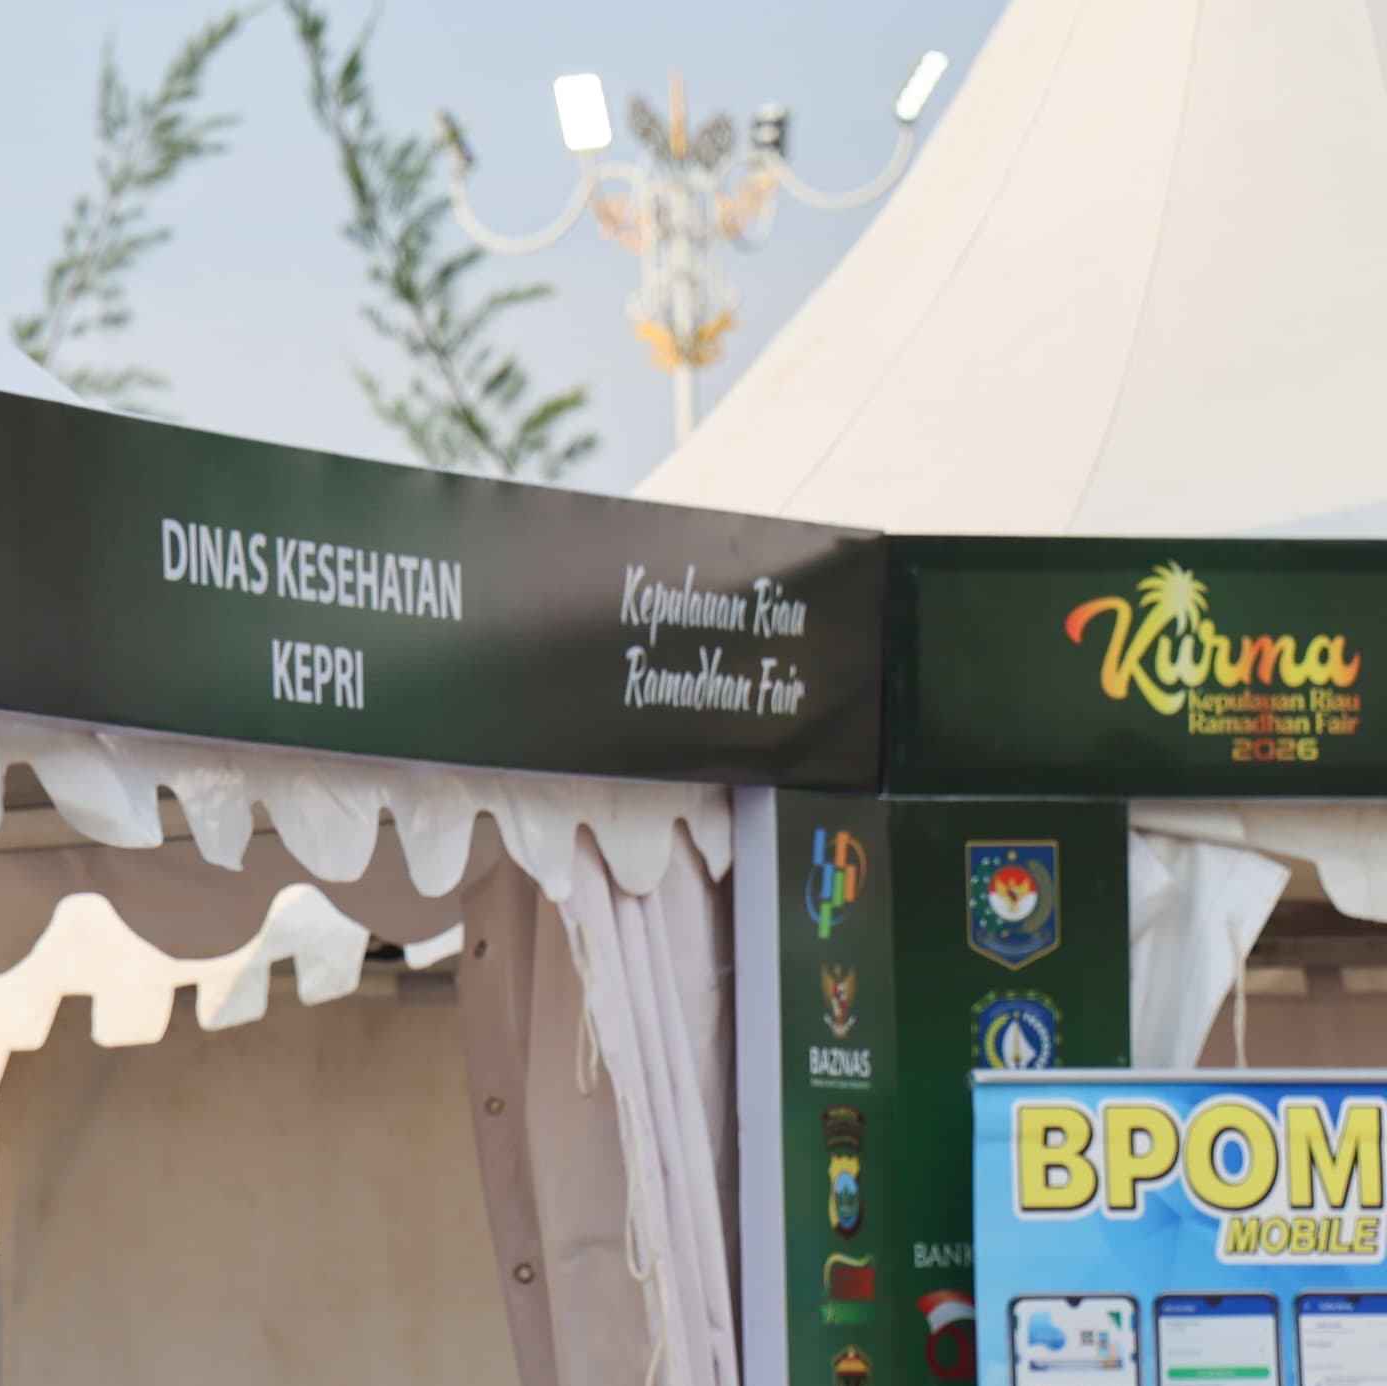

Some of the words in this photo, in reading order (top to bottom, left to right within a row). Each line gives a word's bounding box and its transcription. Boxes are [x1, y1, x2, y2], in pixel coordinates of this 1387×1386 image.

[161, 517, 268, 594] DINAS
[276, 535, 462, 621] KESEHATAN
[621, 564, 746, 645] Kepulauan
[753, 577, 806, 638] Riau
[272, 639, 364, 709] KEPRI
[1064, 559, 1361, 716] Kurma
[624, 645, 750, 713] Ramadhan
[758, 657, 805, 716] Fair
[1231, 737, 1319, 761] 2026
[1015, 1099, 1385, 1216] BPOM
[1224, 1215, 1380, 1256] MOBILE
